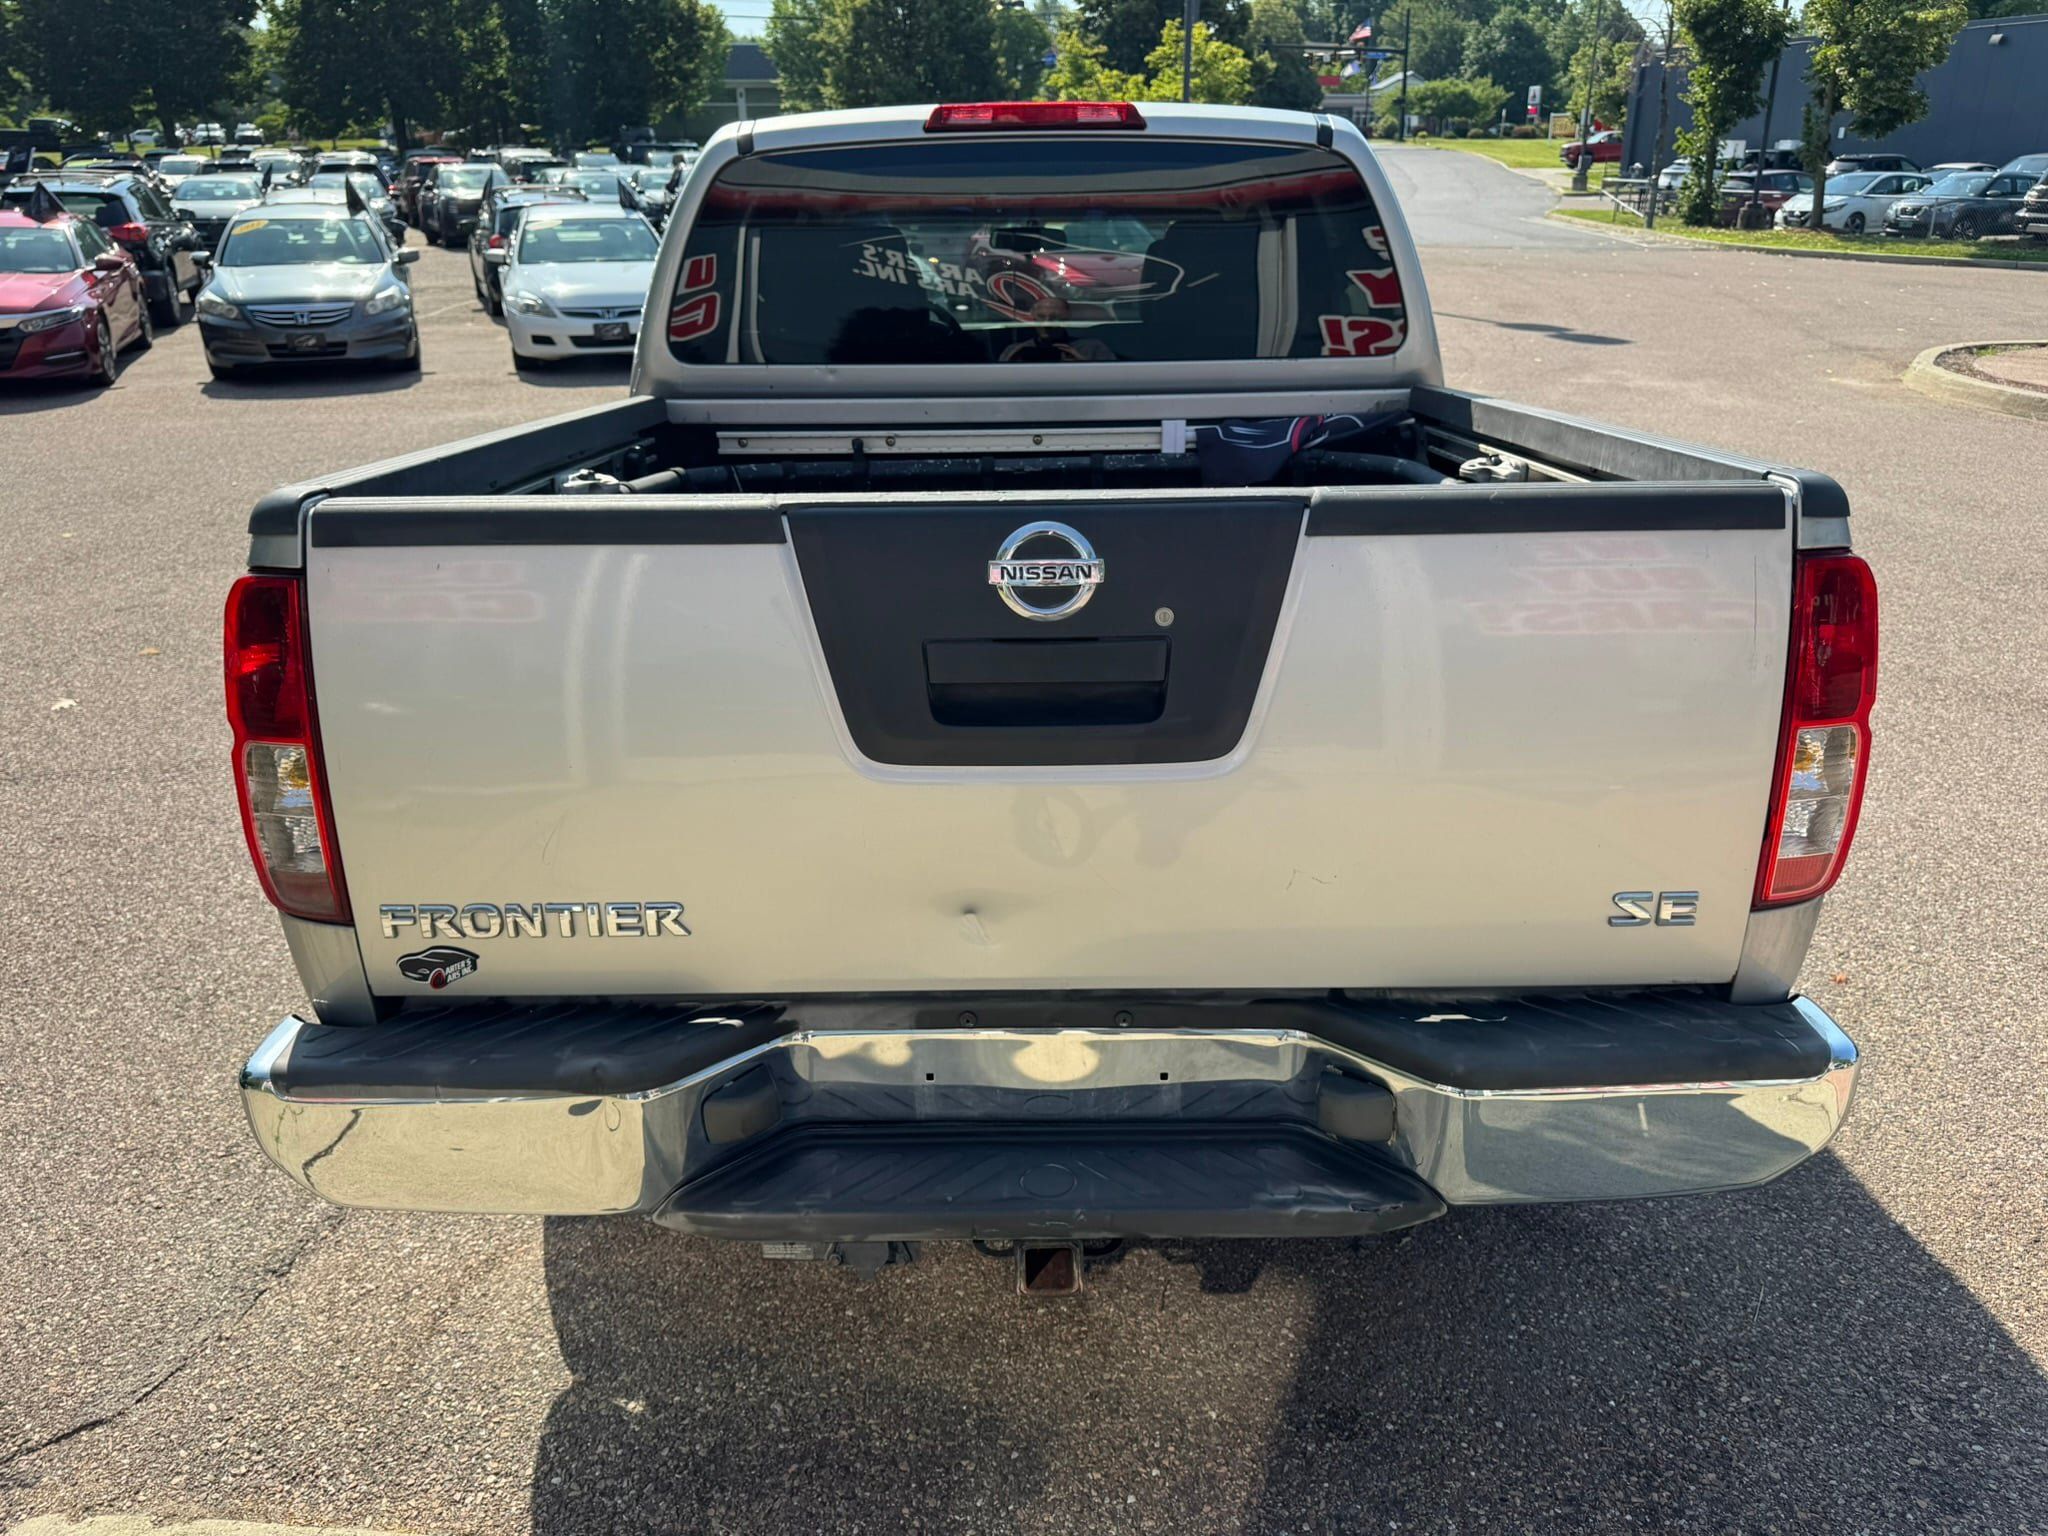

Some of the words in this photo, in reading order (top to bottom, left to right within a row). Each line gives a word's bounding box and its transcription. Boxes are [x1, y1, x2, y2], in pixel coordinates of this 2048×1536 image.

[999, 564, 1093, 580] NISSAN
[379, 901, 692, 939] FRONTIER
[1608, 890, 1699, 928] SE
